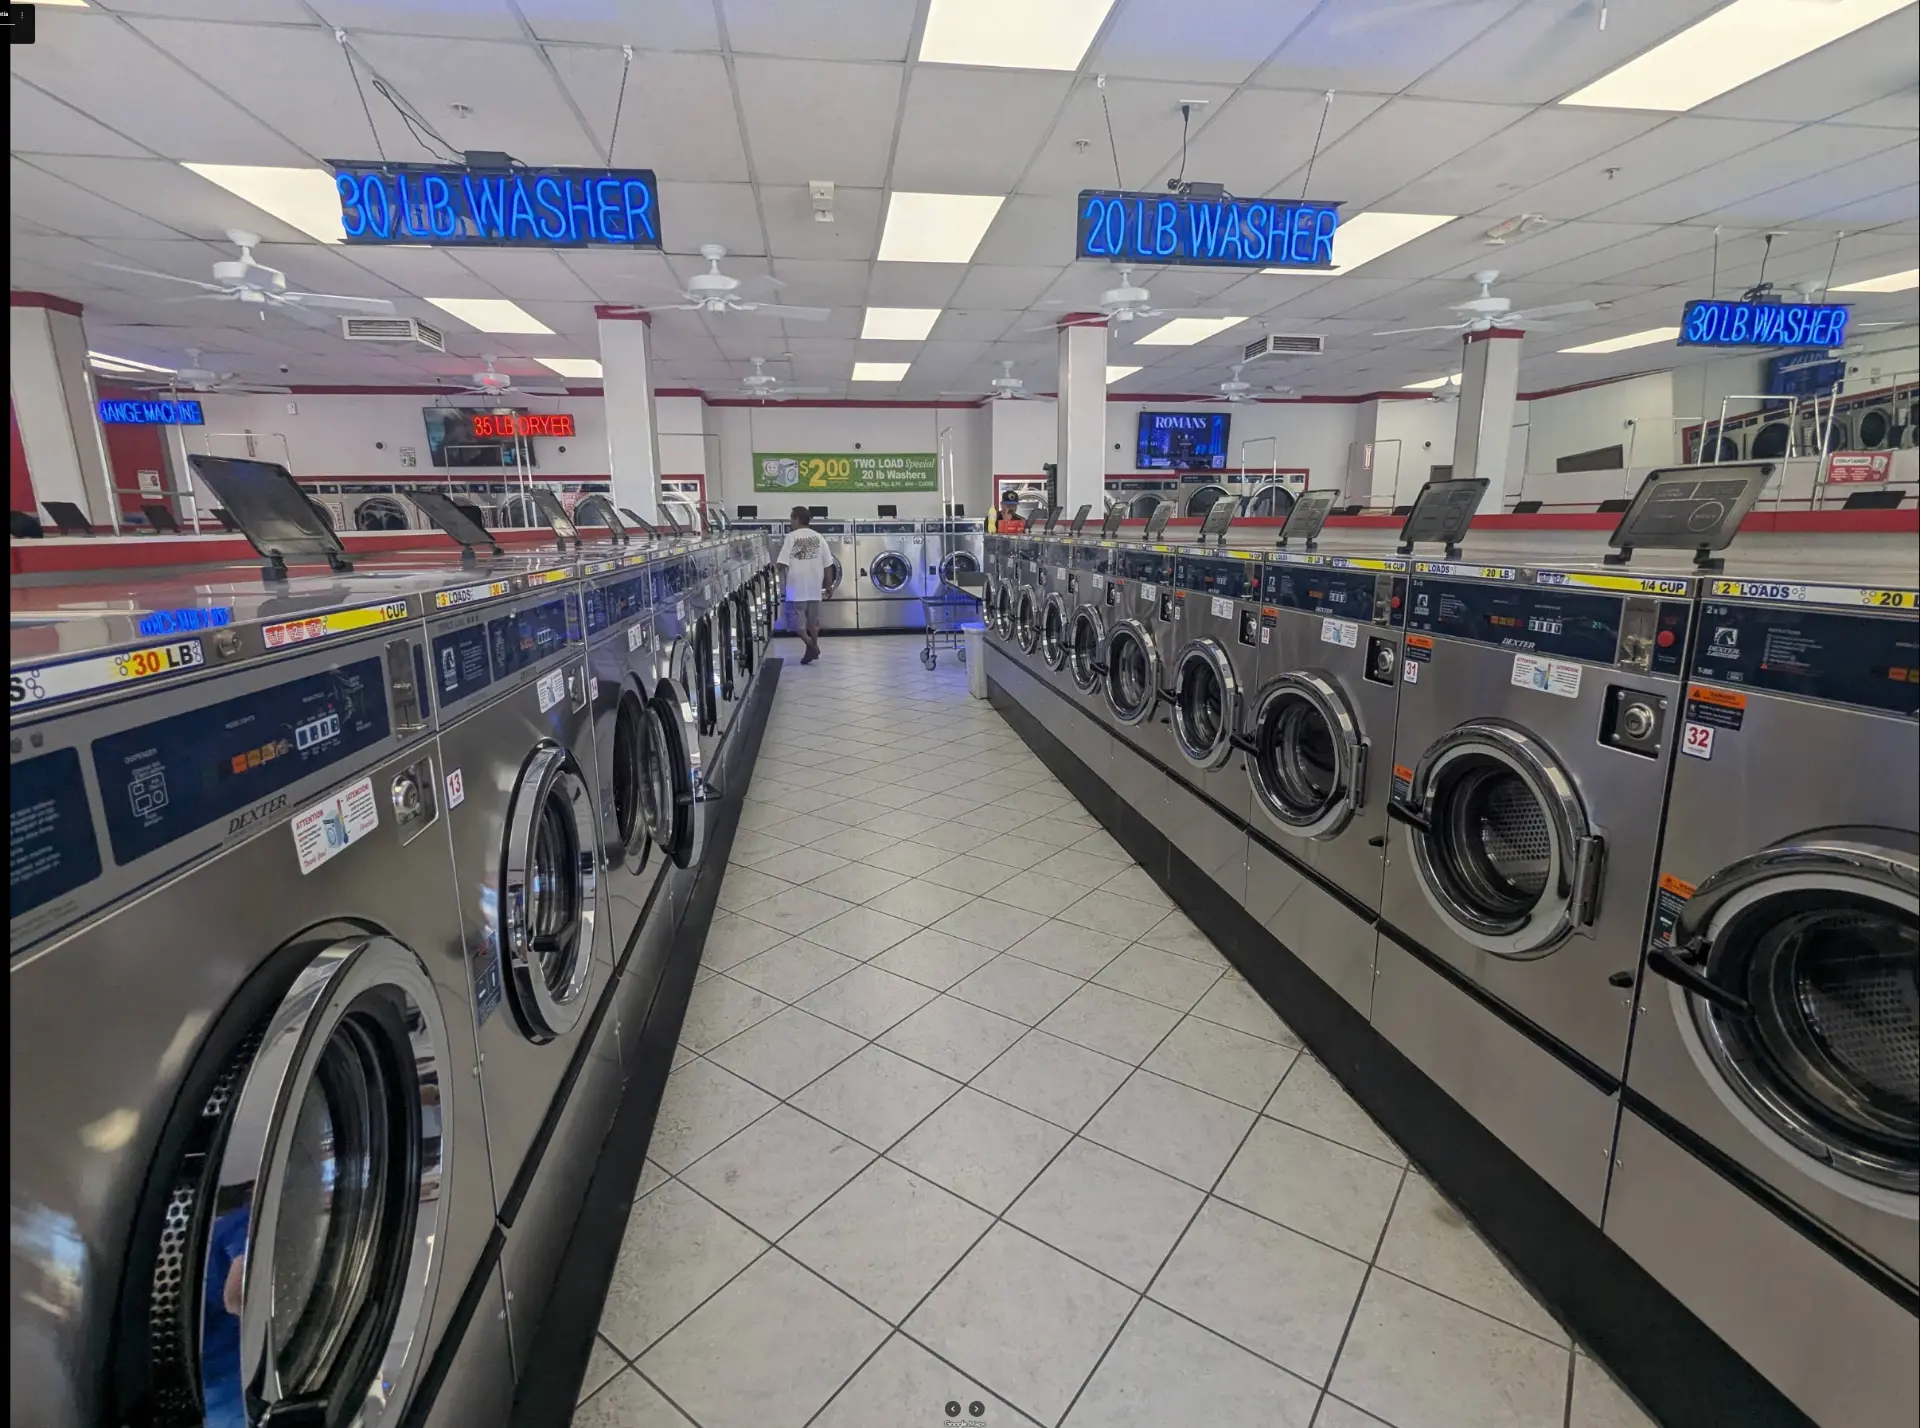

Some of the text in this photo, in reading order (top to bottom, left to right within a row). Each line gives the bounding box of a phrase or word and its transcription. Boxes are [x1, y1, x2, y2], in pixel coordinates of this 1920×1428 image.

[337, 173, 655, 240] 30 LB WASHER
[1085, 199, 1337, 262] 20 LB WASHER
[1687, 305, 1846, 346] 30 LB WASHER
[474, 415, 573, 436] 35 LB DRYER
[1155, 416, 1206, 429] ROMANS
[853, 458, 936, 471] TWO LOAD Special
[862, 470, 927, 480] 20 lb Washers
[1393, 562, 1405, 571] CUP
[1420, 563, 1450, 574] 2 LOADS
[1486, 568, 1510, 580] 20 LB
[501, 580, 508, 595] LB
[1640, 580, 1684, 594] 1/4 CUP
[1722, 583, 1790, 600] 2 LOADS
[440, 588, 471, 607] 3 LOADS
[1880, 592, 1904, 607] 20
[380, 602, 407, 622] 1 CUP
[1706, 605, 1713, 614] 2
[1501, 637, 1535, 649] DEXTER
[132, 645, 193, 678] 30 LB
[1406, 662, 1417, 677] 31
[1688, 726, 1710, 748] 32
[449, 773, 461, 795] 13
[228, 793, 289, 835] DEXTER
[295, 809, 325, 831] ATTENTION
